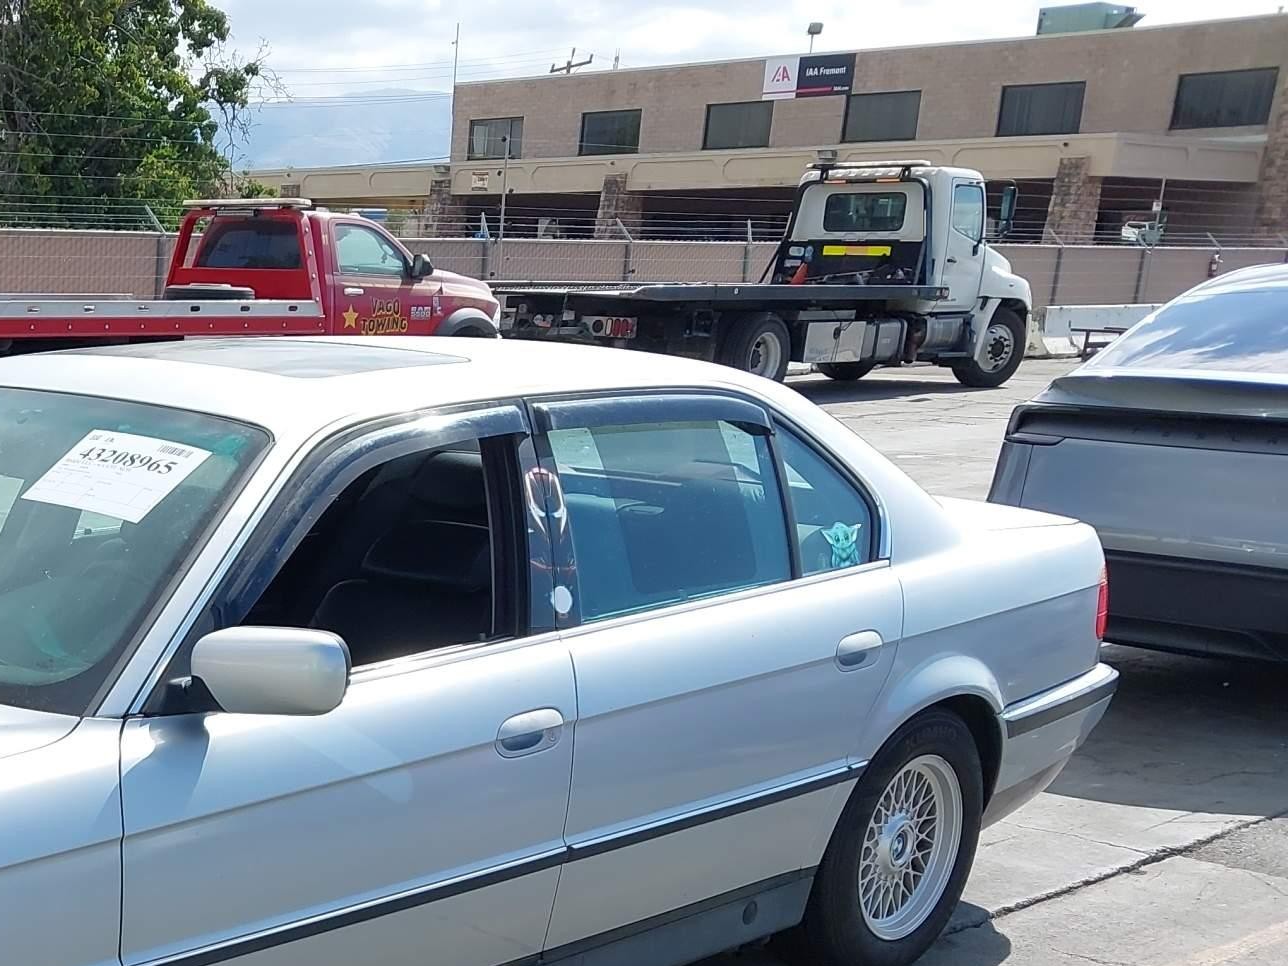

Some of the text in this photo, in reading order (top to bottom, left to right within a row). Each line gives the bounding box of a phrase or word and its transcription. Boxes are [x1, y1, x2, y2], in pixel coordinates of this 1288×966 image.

[806, 66, 846, 76] IAA Fremont
[361, 316, 408, 334] TOWING
[79, 446, 179, 475] 43208965
